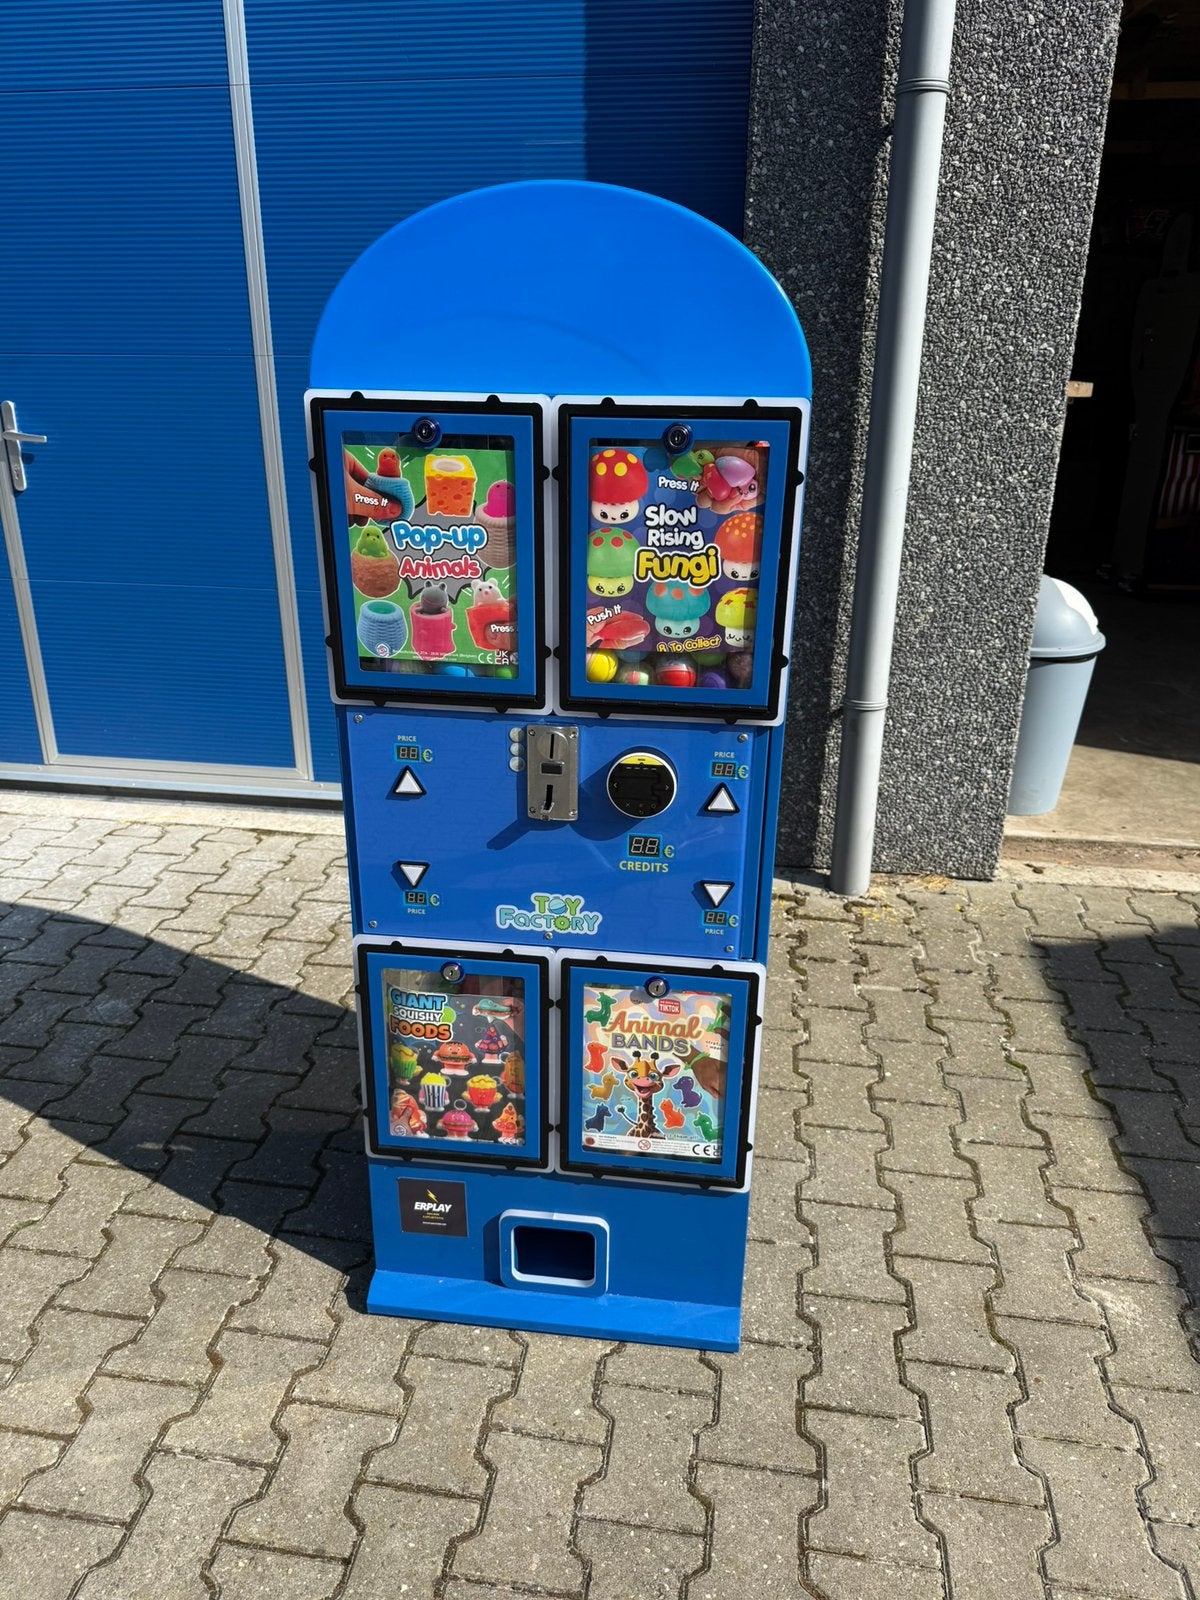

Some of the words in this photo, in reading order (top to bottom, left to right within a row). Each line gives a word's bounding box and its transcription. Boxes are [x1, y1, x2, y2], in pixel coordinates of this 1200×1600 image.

[658, 476, 688, 490] Press
[690, 480, 700, 492] It
[354, 493, 379, 506] Press
[381, 497, 389, 507] It
[645, 504, 697, 527] Slow
[391, 521, 487, 554] Pop-up
[648, 528, 705, 550] Rising
[399, 556, 481, 579] Animals
[637, 546, 719, 586] Fungi
[587, 608, 612, 625] Push
[614, 604, 622, 615] It
[490, 624, 515, 633] Press
[670, 642, 682, 652] To
[684, 635, 721, 651] Collect
[714, 751, 735, 759] PRICE
[619, 861, 669, 873] CREDITS
[534, 895, 582, 916] TOY
[391, 988, 445, 1010] GIANT
[393, 1006, 442, 1021] SQUISHY
[391, 1015, 452, 1040] FOODS
[602, 1011, 703, 1039] Animal
[611, 1032, 690, 1055] BANDS
[414, 1201, 452, 1213] ERPLAY
